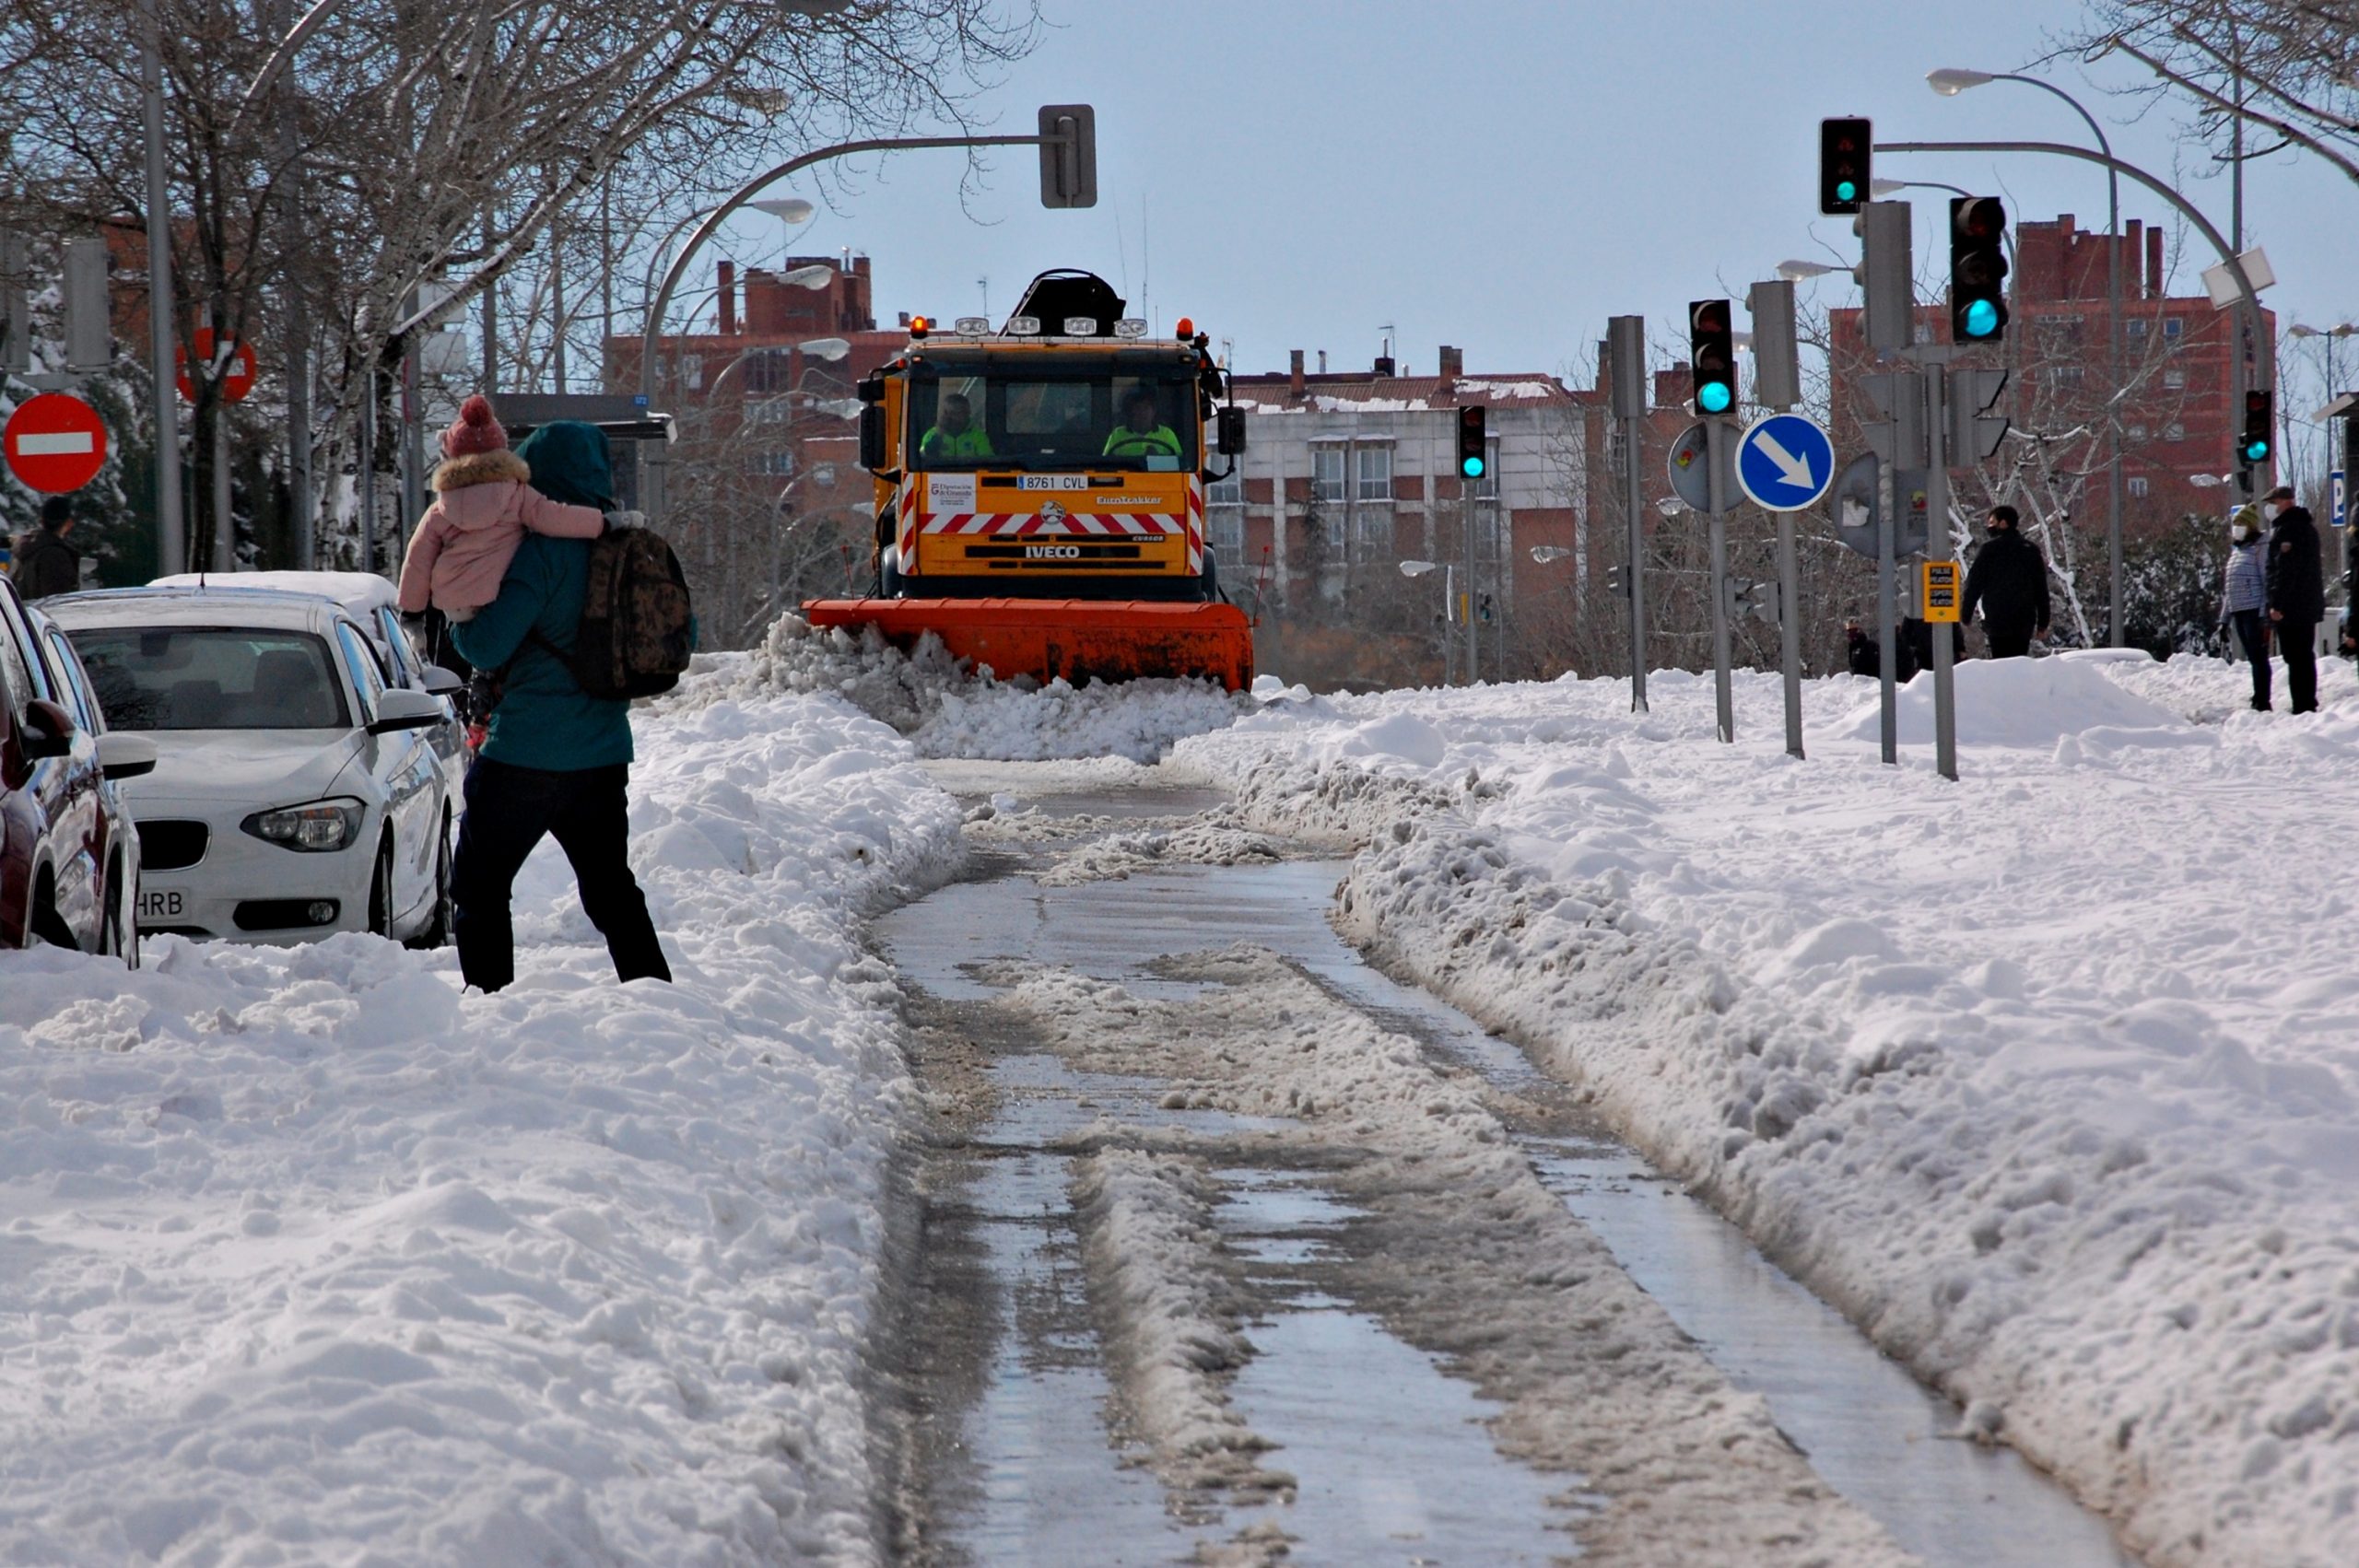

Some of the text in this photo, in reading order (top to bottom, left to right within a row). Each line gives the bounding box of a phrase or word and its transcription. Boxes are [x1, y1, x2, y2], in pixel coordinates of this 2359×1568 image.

[1027, 477, 1055, 488] 8761
[1063, 477, 1085, 488] CVL
[1097, 496, 1162, 505] EuroTrakker
[2333, 478, 2344, 519] P
[1026, 545, 1080, 558] IVECO
